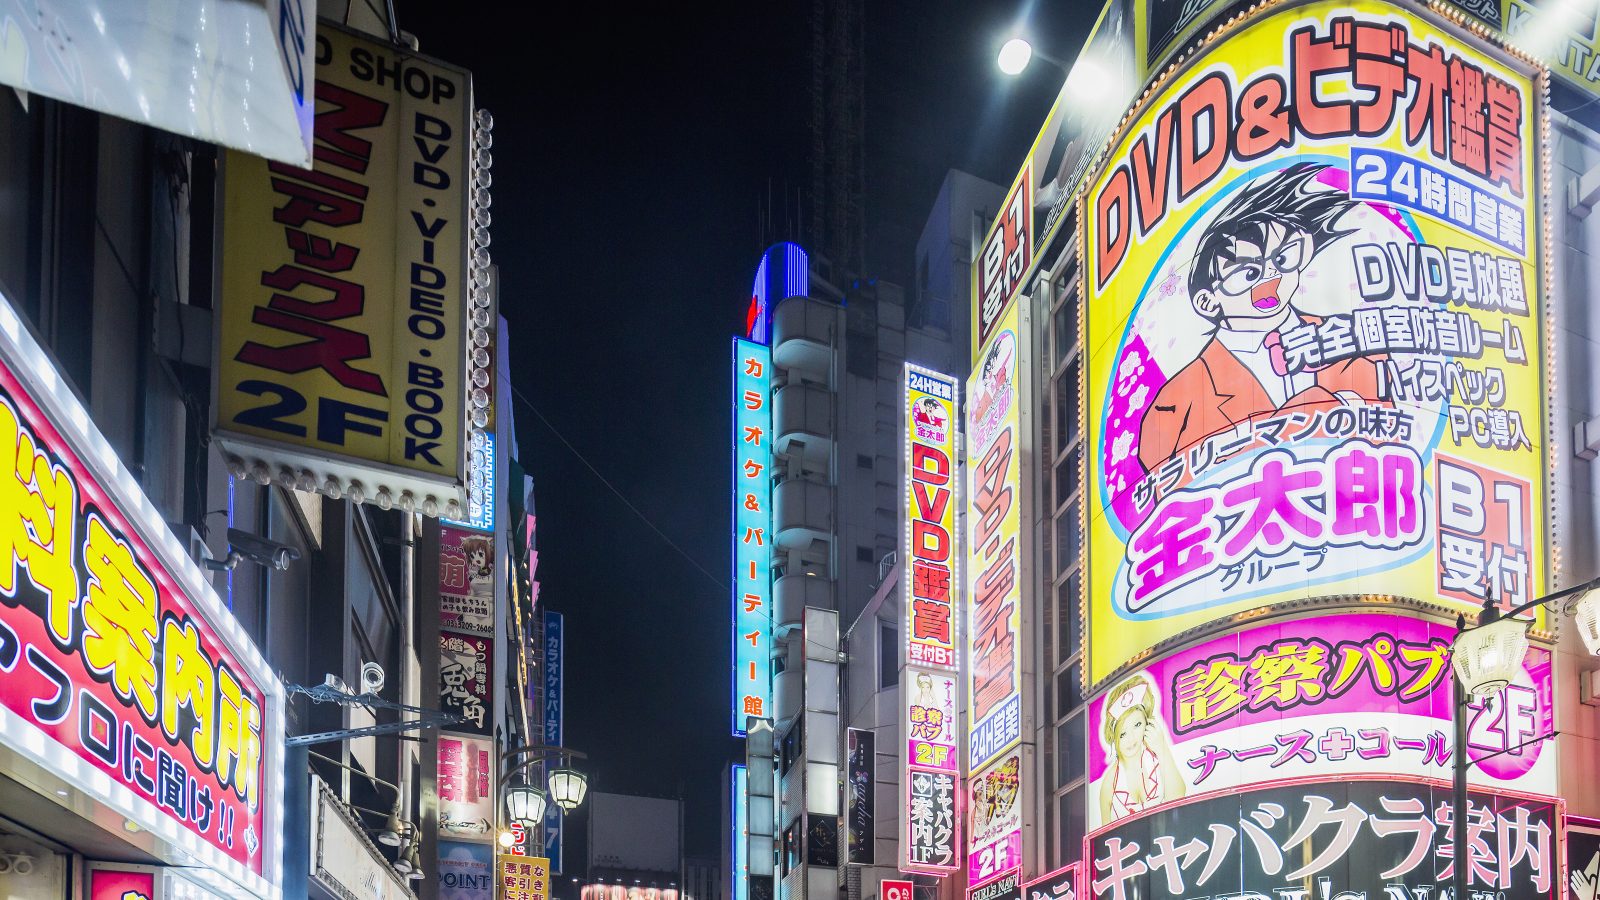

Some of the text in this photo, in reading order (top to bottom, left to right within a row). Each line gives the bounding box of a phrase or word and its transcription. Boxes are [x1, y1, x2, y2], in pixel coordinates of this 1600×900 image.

[350, 47, 456, 105] SHOP
[1098, 16, 1524, 291] DVD&ビデオ鑑賞
[1355, 153, 1523, 248] 24時間営業
[1352, 241, 1530, 317] DVD見放題
[1280, 306, 1528, 373] 完全個室防音ルーム
[233, 379, 390, 448] 2F
[910, 373, 952, 400] 24H営業
[1375, 358, 1506, 407] ハイスペック
[917, 427, 945, 443] 金太郎
[1131, 405, 1415, 509] サラリーマンの味方
[1449, 404, 1533, 452] PC導入
[743, 358, 764, 716] カラオケ&パーティー館
[1130, 444, 1421, 607] 金太郎
[1437, 458, 1526, 552] B1
[911, 441, 951, 644] DVD鑑賞
[1219, 547, 1329, 592] グループ
[1439, 536, 1528, 606] 受付
[910, 643, 953, 665] 受付B1
[1173, 634, 1453, 731] 診察パブ
[915, 742, 948, 766] 2F
[971, 699, 1019, 768] 24H営業
[1467, 684, 1538, 757] 2F
[504, 862, 545, 877] 悪質な
[978, 839, 1009, 881] 2F
[1092, 795, 1554, 895] キャバクラ案内
[504, 876, 544, 891] 客引き
